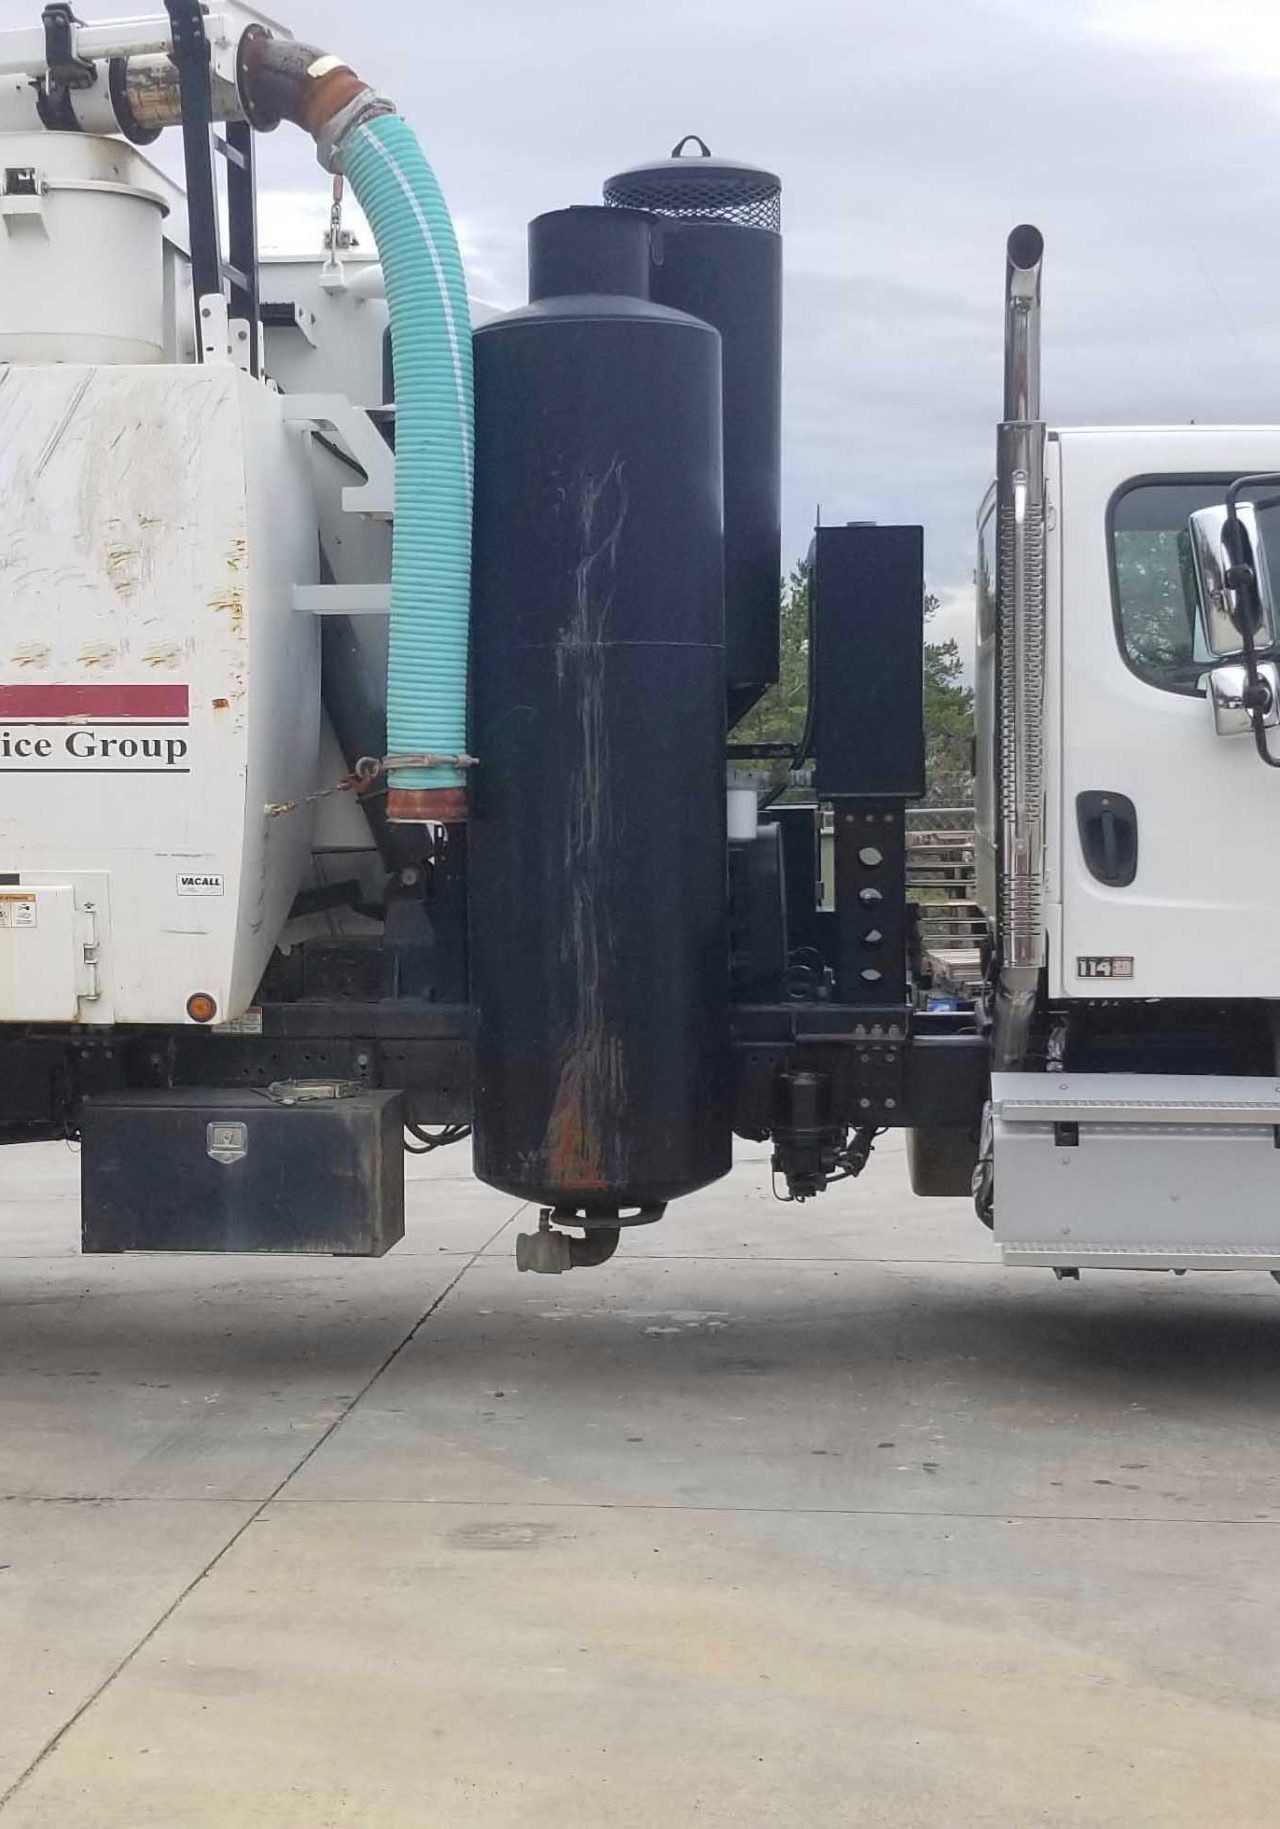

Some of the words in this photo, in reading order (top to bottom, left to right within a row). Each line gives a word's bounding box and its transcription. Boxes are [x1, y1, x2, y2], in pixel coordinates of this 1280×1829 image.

[65, 731, 187, 765] Group
[181, 877, 220, 886] VACALL
[1079, 960, 1111, 977] 114
